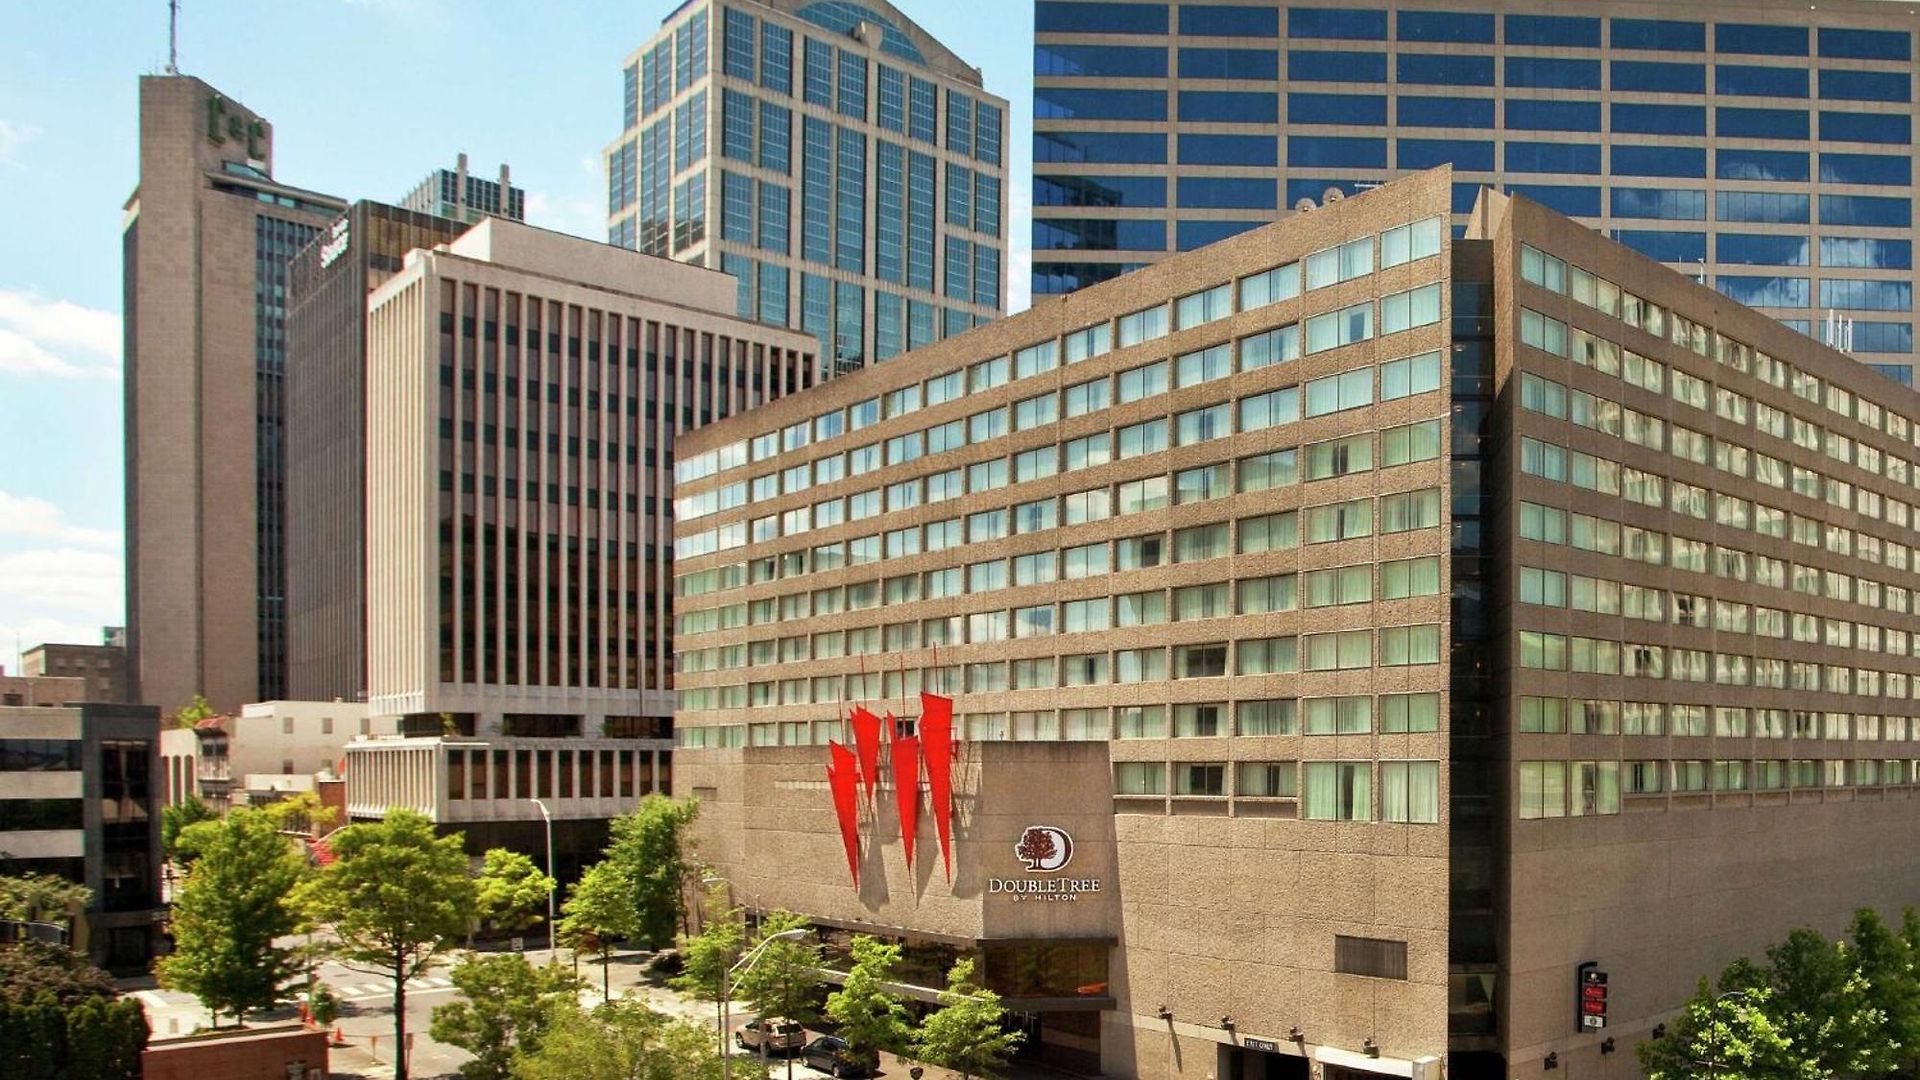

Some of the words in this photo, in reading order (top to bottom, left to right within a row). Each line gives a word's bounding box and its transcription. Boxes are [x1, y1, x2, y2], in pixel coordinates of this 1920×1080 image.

[989, 877, 1101, 893] DOUBLETREE
[1013, 894, 1028, 902] BY
[1034, 894, 1077, 902] HILTON
